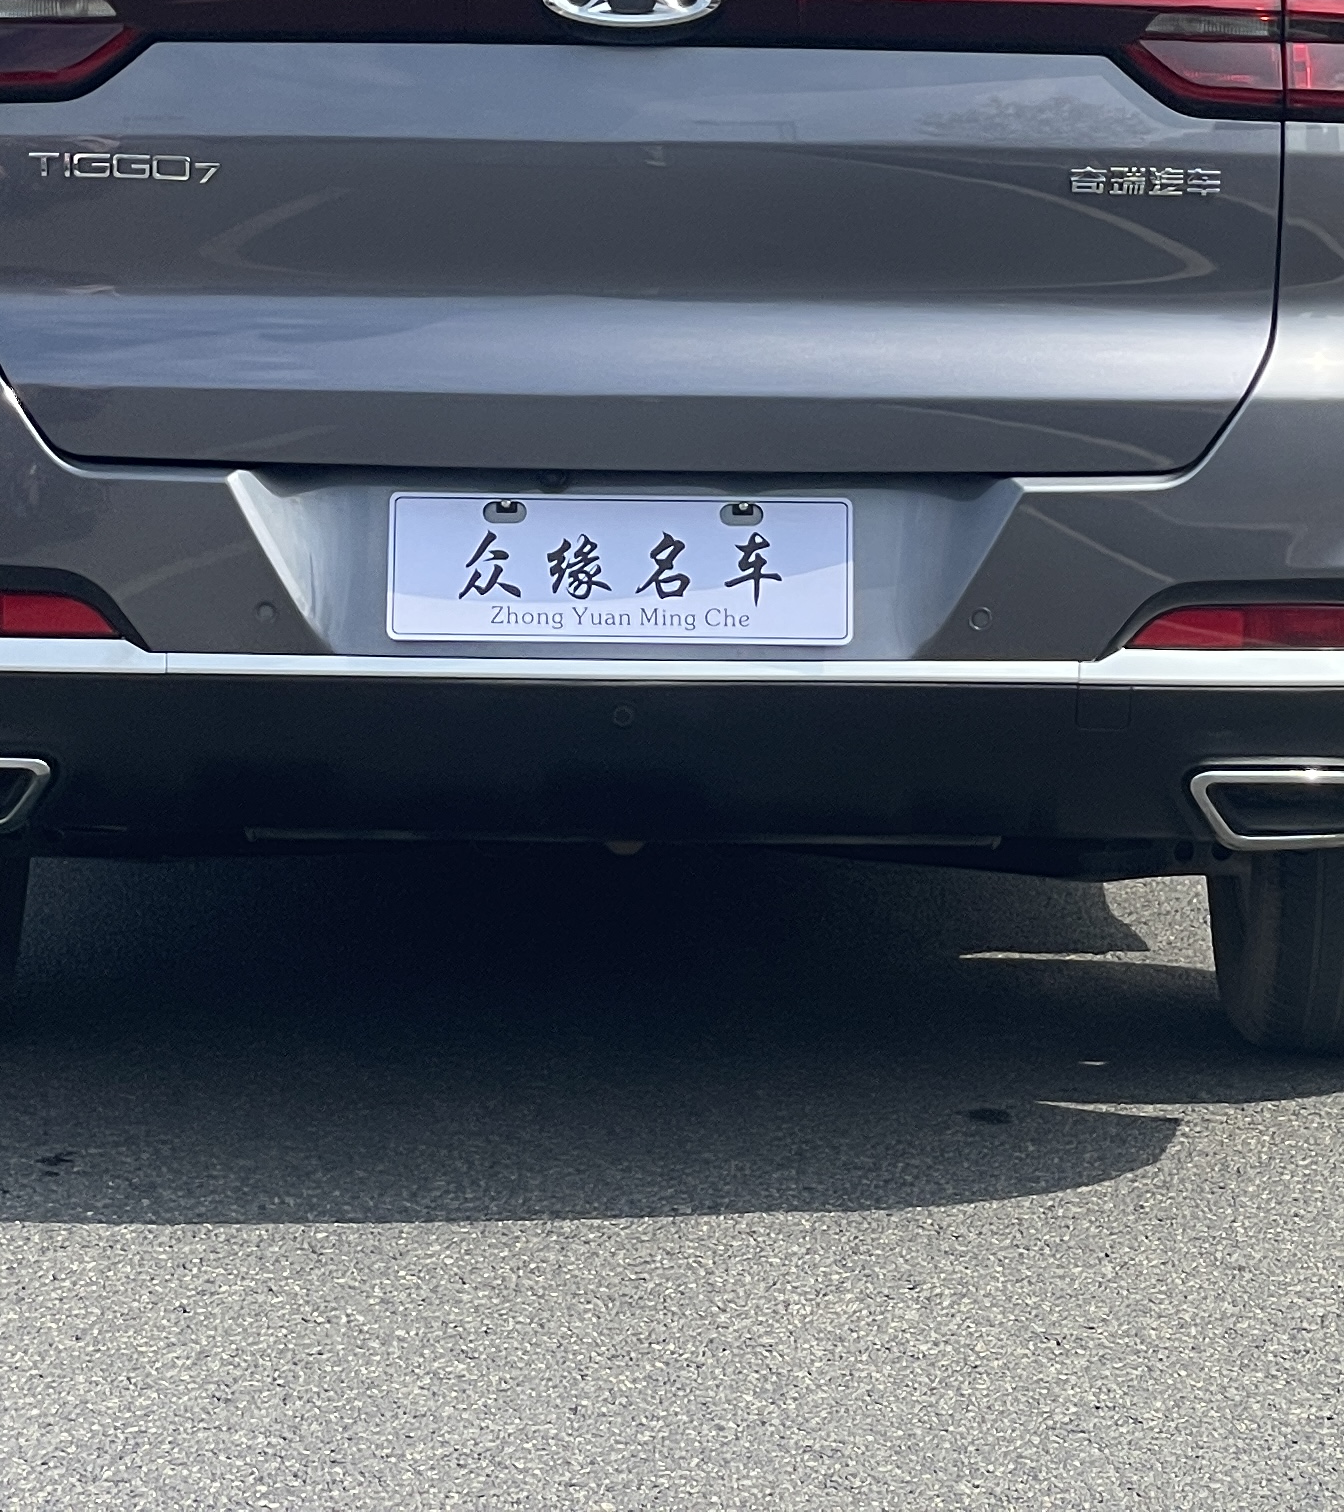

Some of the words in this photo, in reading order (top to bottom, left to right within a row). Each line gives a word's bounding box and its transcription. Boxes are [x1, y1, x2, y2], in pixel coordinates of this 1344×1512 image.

[1071, 166, 1222, 196] 奇瑞汽车
[458, 529, 783, 606] 众缘名车
[491, 606, 564, 629] Zhong
[573, 607, 631, 627] Yuan
[640, 608, 697, 630] Ming
[704, 608, 750, 628] Che
